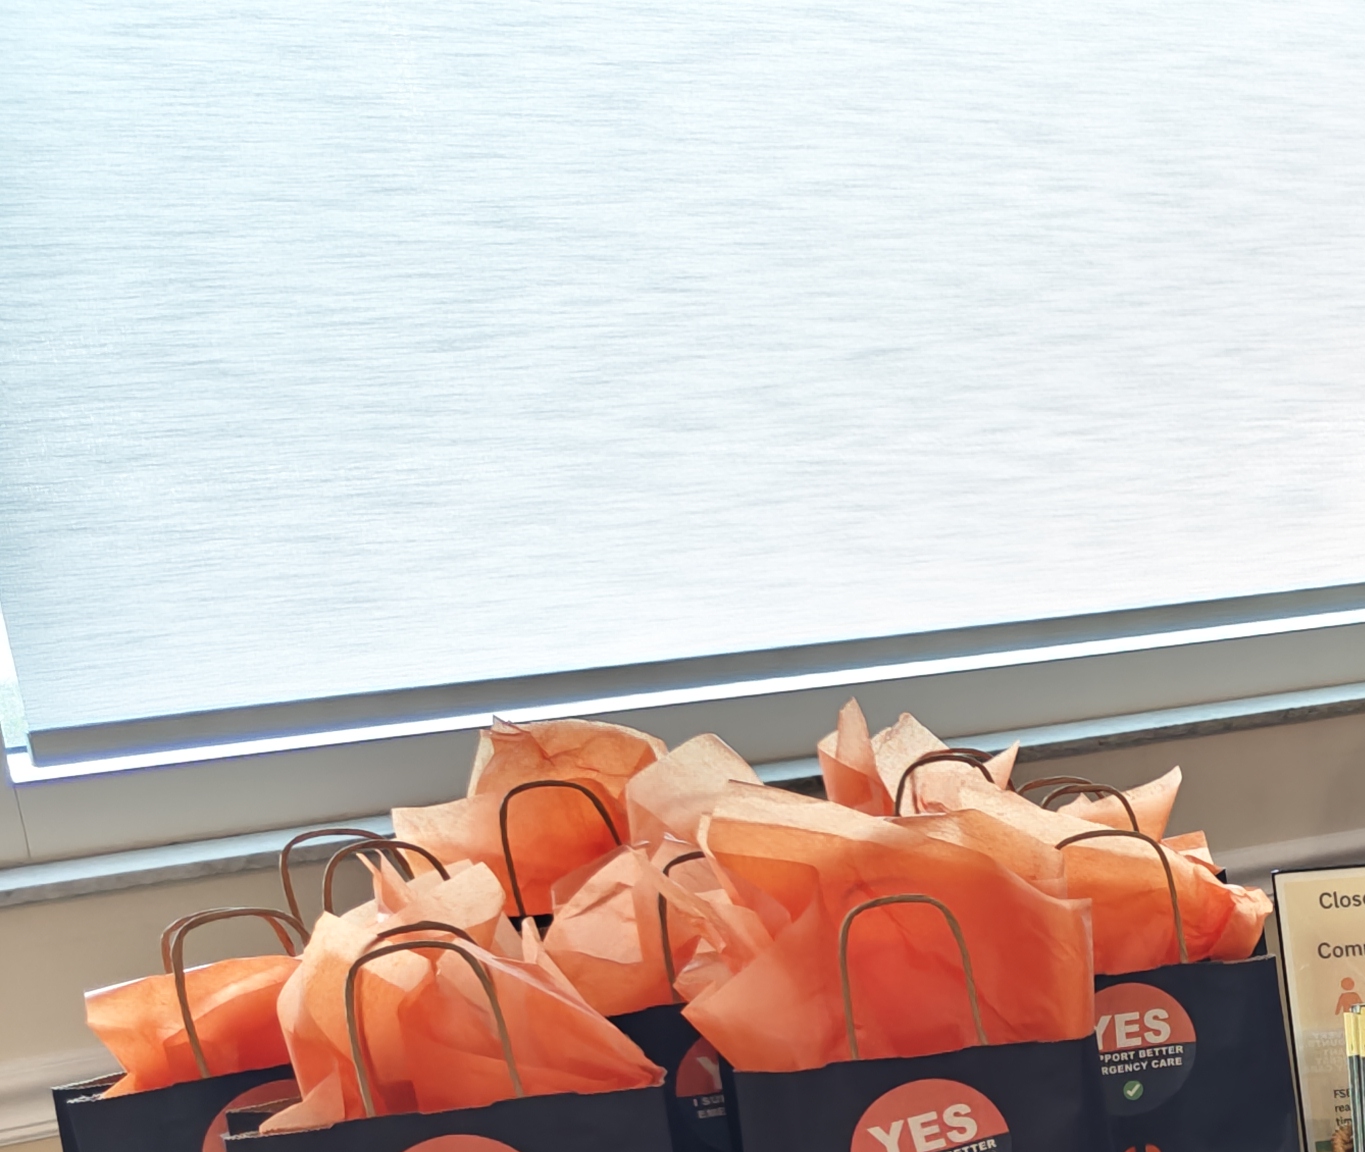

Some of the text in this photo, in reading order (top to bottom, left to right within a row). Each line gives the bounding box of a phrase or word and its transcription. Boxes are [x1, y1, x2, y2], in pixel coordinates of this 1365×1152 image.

[1094, 1008, 1170, 1050] YES
[1139, 1045, 1183, 1058] BETTER
[1151, 1057, 1182, 1068] CARE
